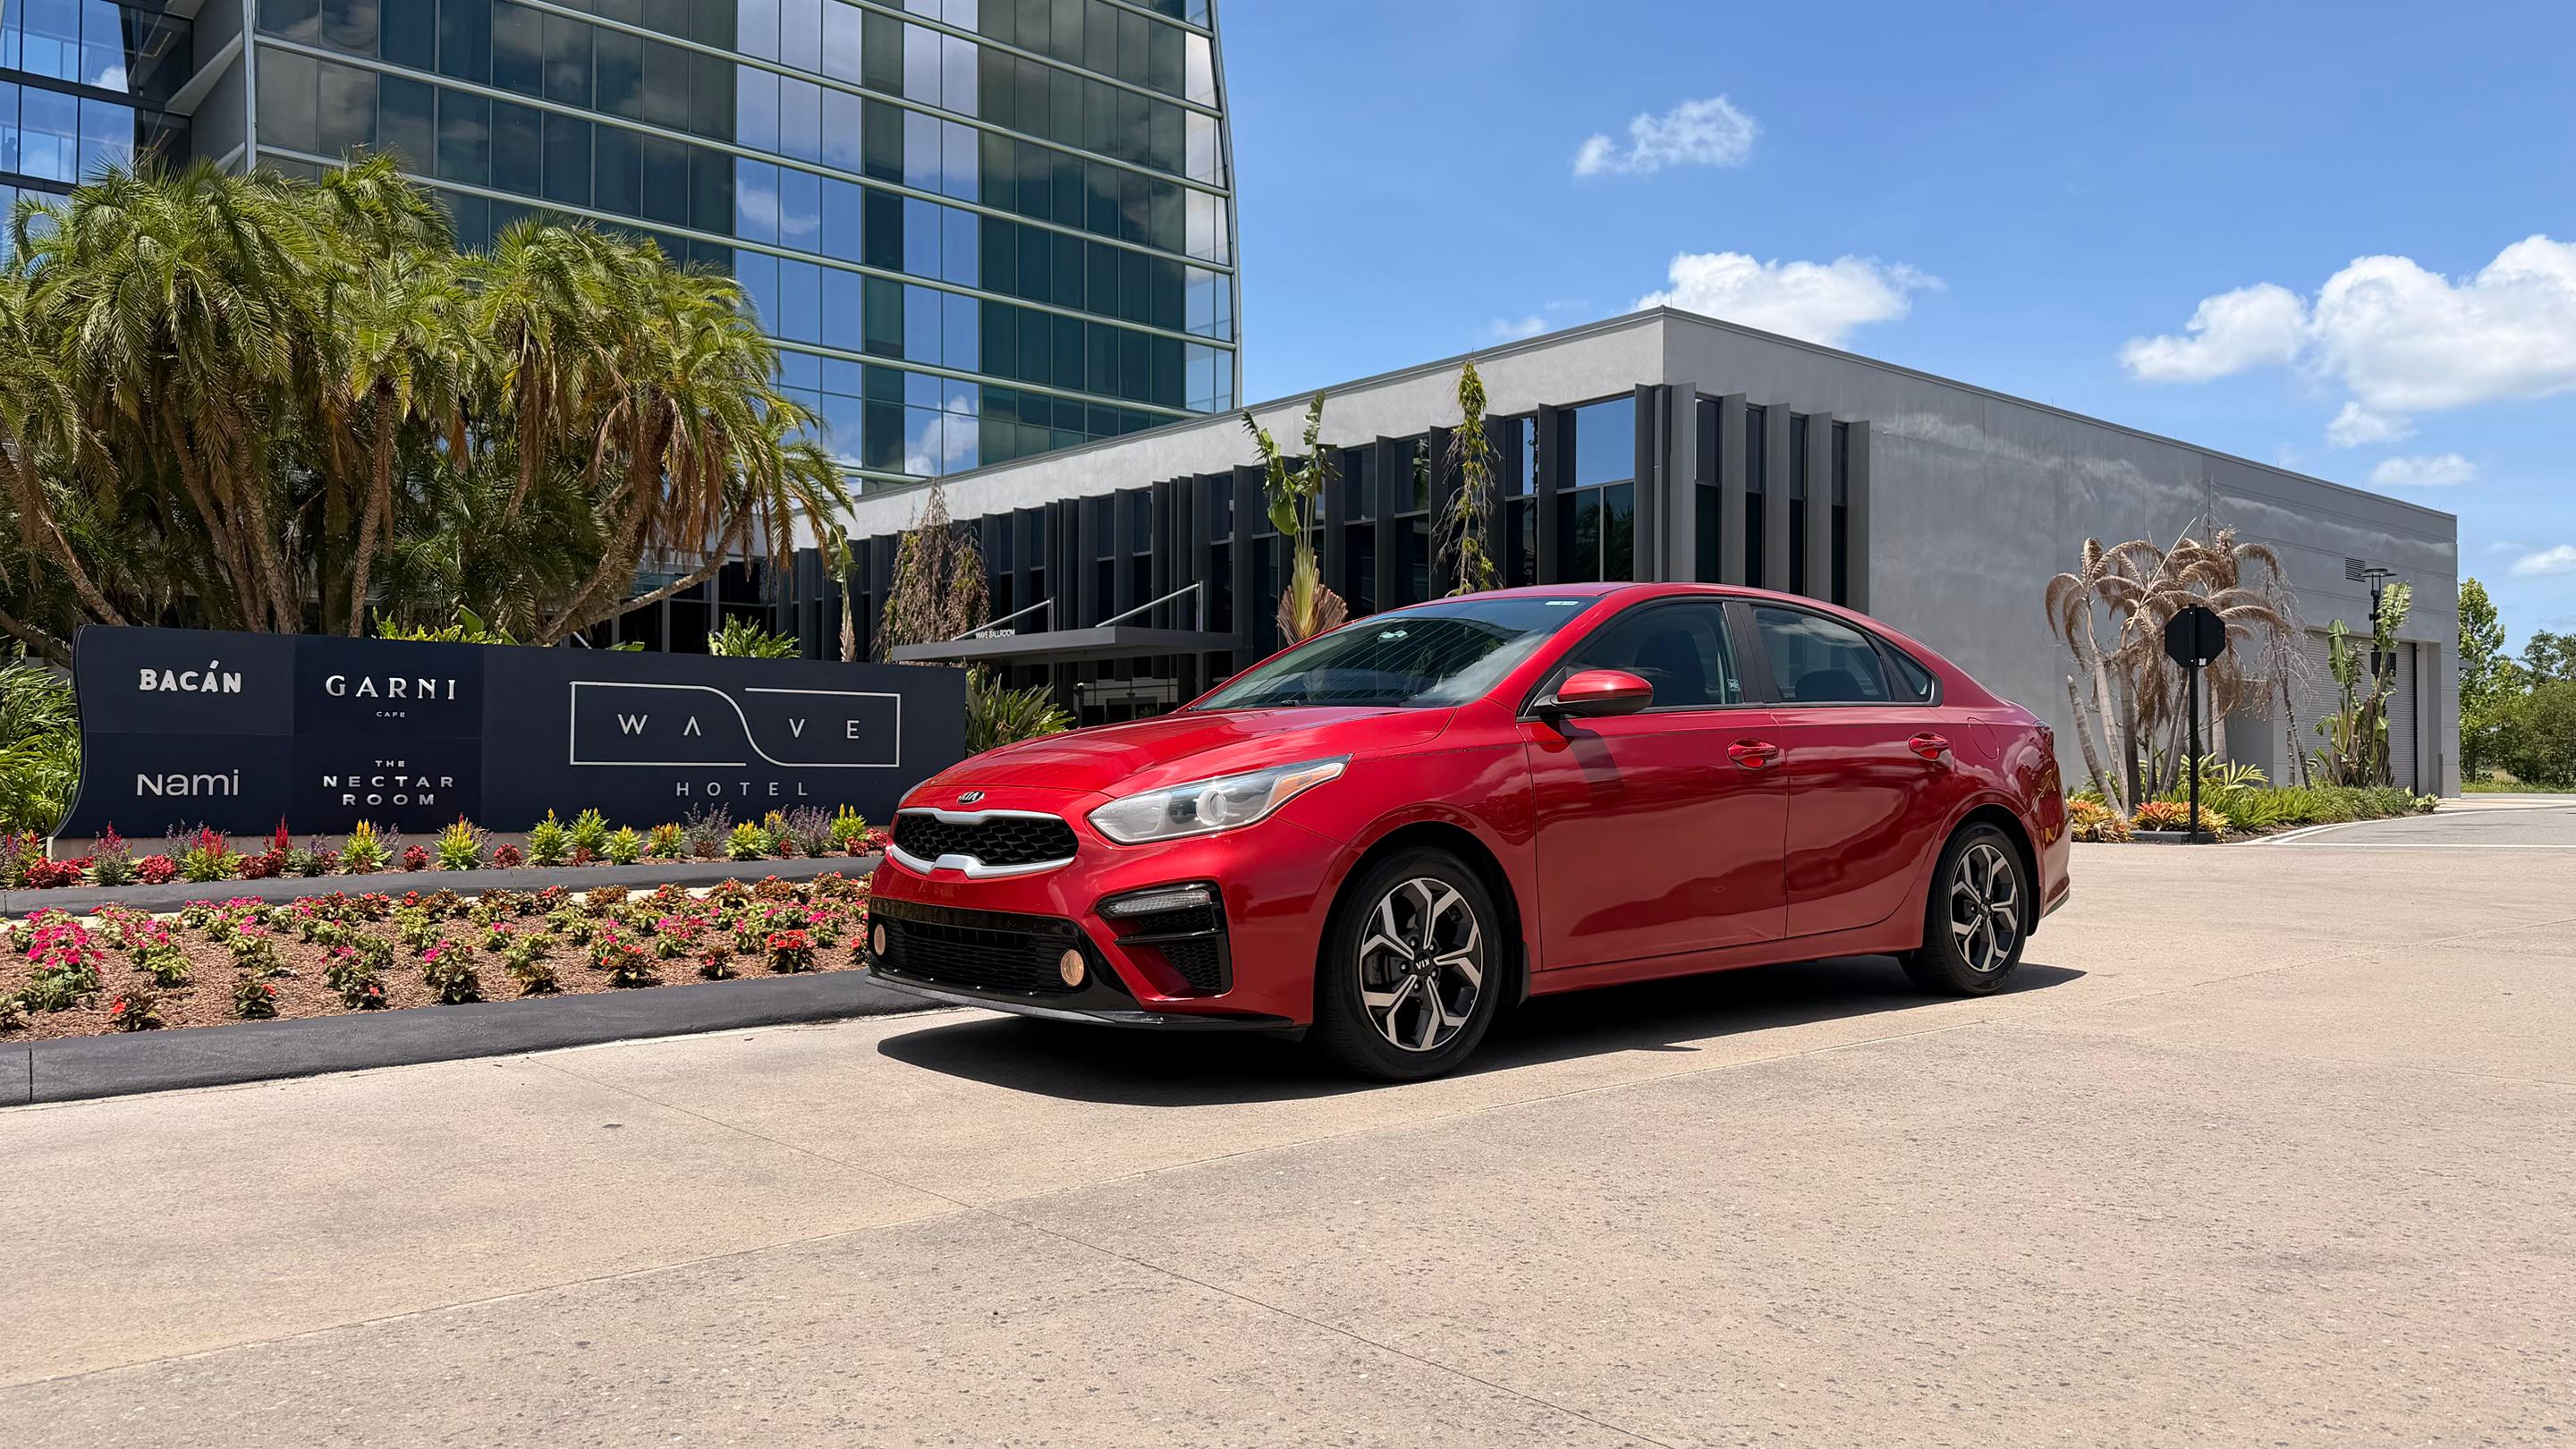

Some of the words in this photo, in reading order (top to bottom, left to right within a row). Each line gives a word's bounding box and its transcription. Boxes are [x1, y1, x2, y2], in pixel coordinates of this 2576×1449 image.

[139, 659, 242, 693] BACÁN
[325, 674, 456, 700] GARNI
[617, 713, 860, 740] WAVE
[375, 759, 405, 767] THE
[137, 768, 239, 796] Nami
[323, 775, 453, 788] NECTAR
[676, 782, 809, 797] HOTEL
[343, 793, 435, 806] ROOM
